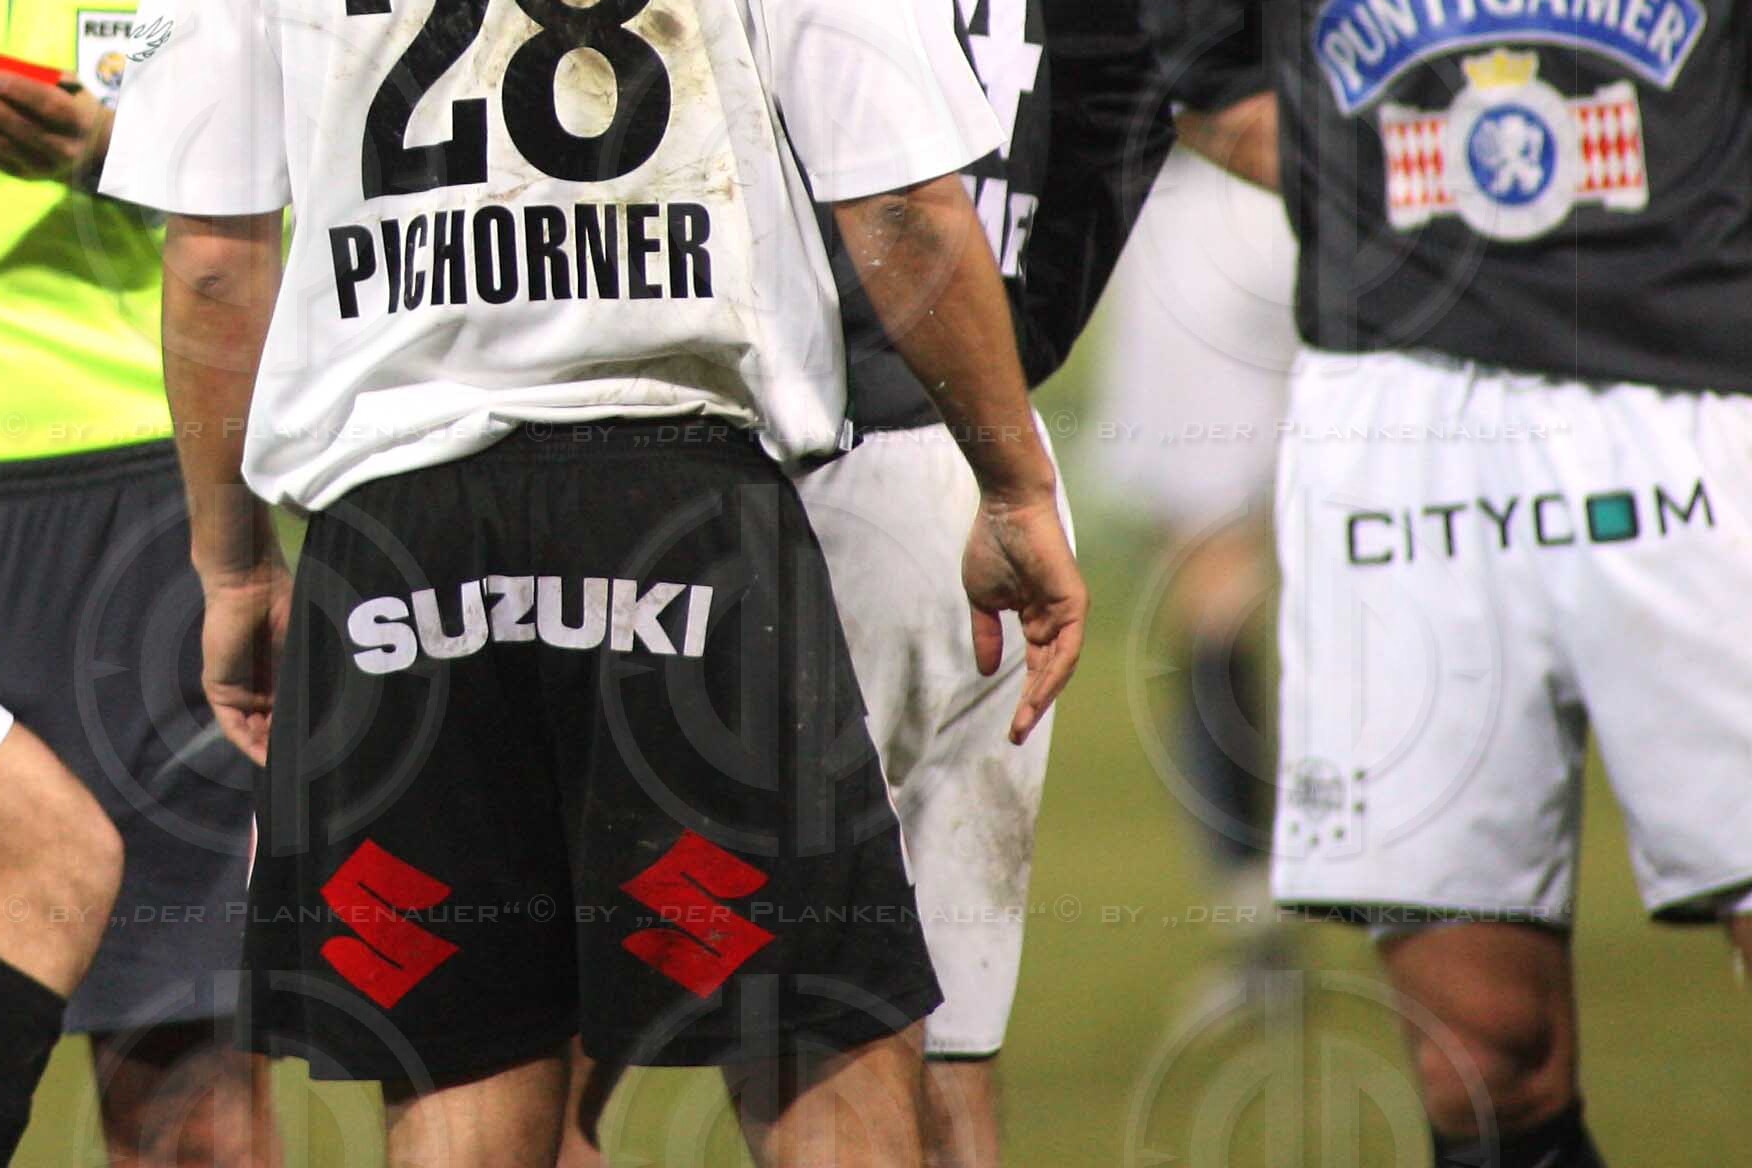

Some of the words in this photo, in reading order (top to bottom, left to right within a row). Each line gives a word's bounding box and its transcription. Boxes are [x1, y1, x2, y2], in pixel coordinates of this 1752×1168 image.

[329, 201, 715, 320] PICHORNER
[1345, 477, 1716, 566] CITYCOM
[348, 574, 713, 675] SUZUKI
